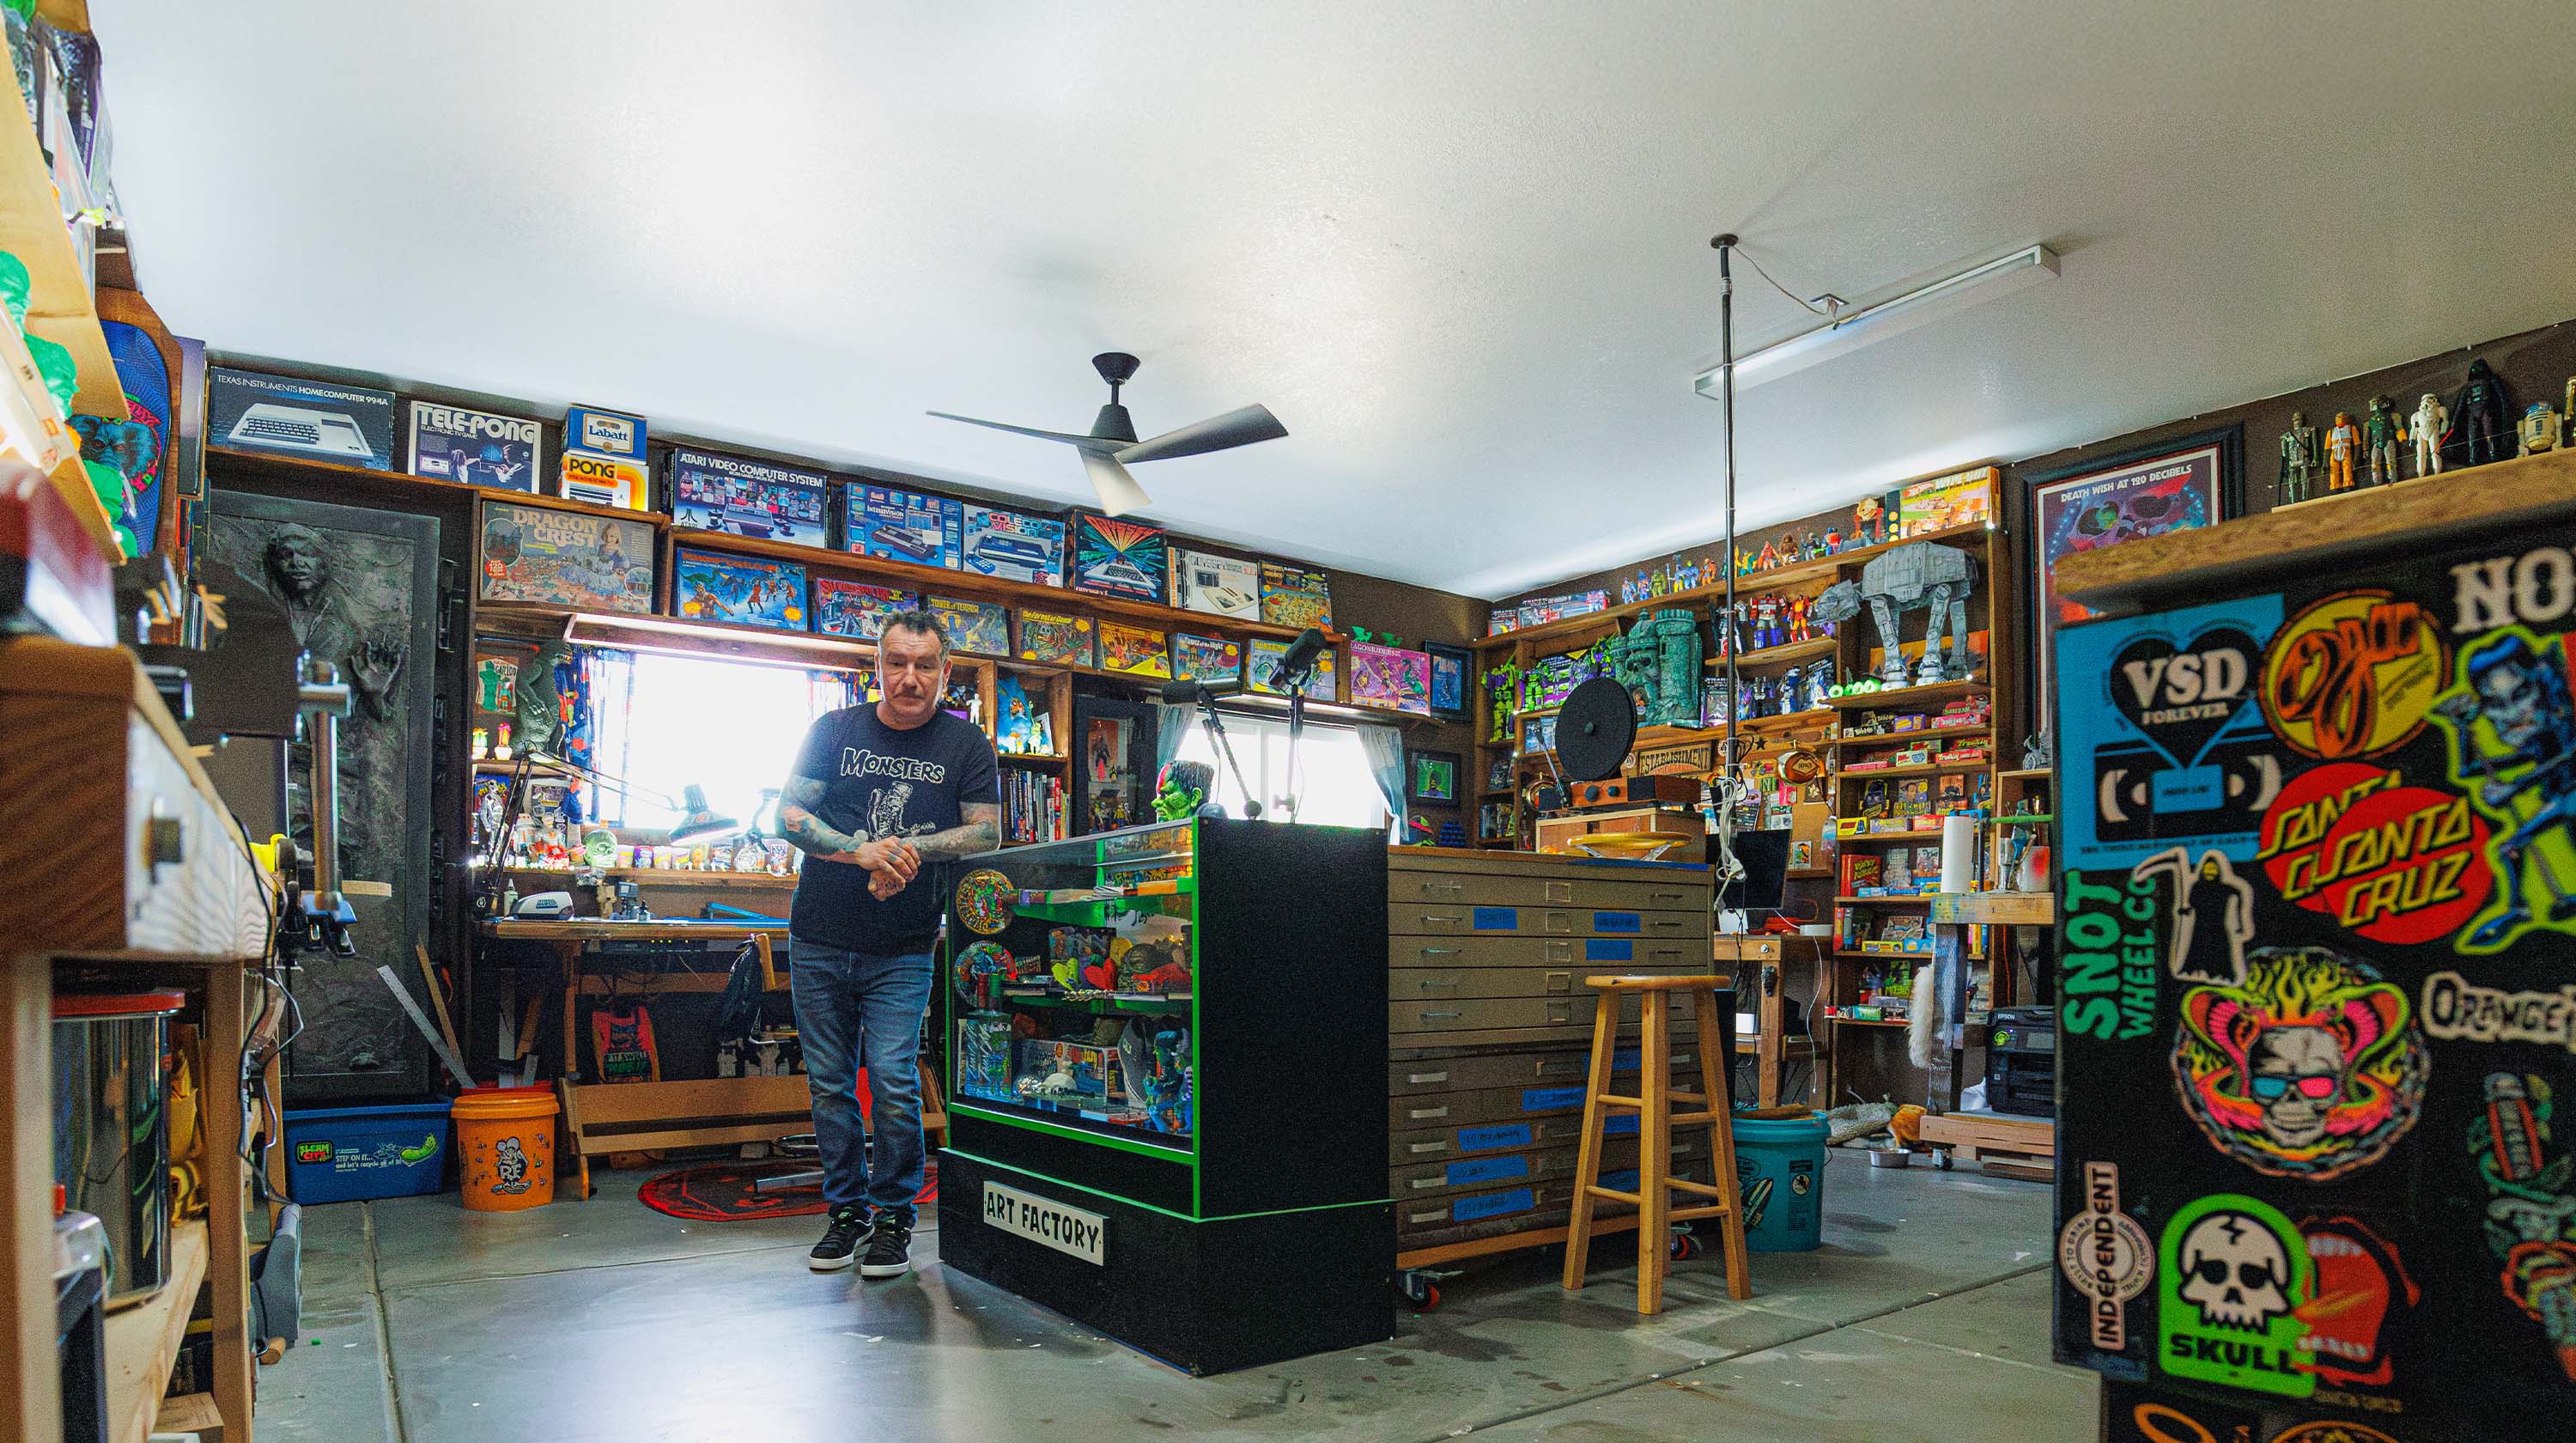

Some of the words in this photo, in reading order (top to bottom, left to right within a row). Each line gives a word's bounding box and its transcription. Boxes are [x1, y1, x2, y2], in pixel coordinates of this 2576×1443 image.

[217, 374, 242, 386] TEXAS
[243, 378, 298, 393] INSTRUMENTS
[299, 387, 323, 397] HOME
[324, 389, 365, 404] COMPUTER
[418, 405, 534, 444] TELE-PONG
[420, 424, 454, 435] ELECTRONIC
[588, 425, 629, 441] Labatt
[569, 459, 615, 479] PONG
[680, 453, 707, 466] ATARI
[708, 457, 738, 472] VIDEO
[739, 464, 788, 482] COMPUTER
[788, 472, 823, 488] SYSTEM
[2061, 486, 2090, 503] DEATH
[2092, 481, 2115, 496] WISH
[2117, 478, 2129, 490] AT
[2131, 474, 2147, 488] 120
[2149, 465, 2192, 483] DECIBELS
[513, 508, 598, 535] DRAGON
[989, 512, 1042, 530] COLECO
[990, 521, 1039, 538] VISION
[2450, 547, 2576, 635] NO
[1351, 642, 1395, 657] AGONRIDERS
[2122, 648, 2248, 710] VSD
[2142, 702, 2230, 726] FOREVER
[840, 746, 945, 784] MONSTERS
[1640, 746, 1710, 776] ESTABLISHMENT
[2315, 796, 2471, 886] SANTA
[2339, 850, 2473, 928] CRUZ
[2063, 869, 2122, 1040] SNOT
[2118, 929, 2156, 1040] WHEEL
[1997, 1013, 2016, 1021] EPSON
[2431, 978, 2576, 1033] ORANGE
[987, 1191, 1015, 1225] ART
[1022, 1202, 1099, 1253] FACTORY
[2091, 1167, 2118, 1343] INDEPENDENT
[2170, 1333, 2302, 1376] SKULL
